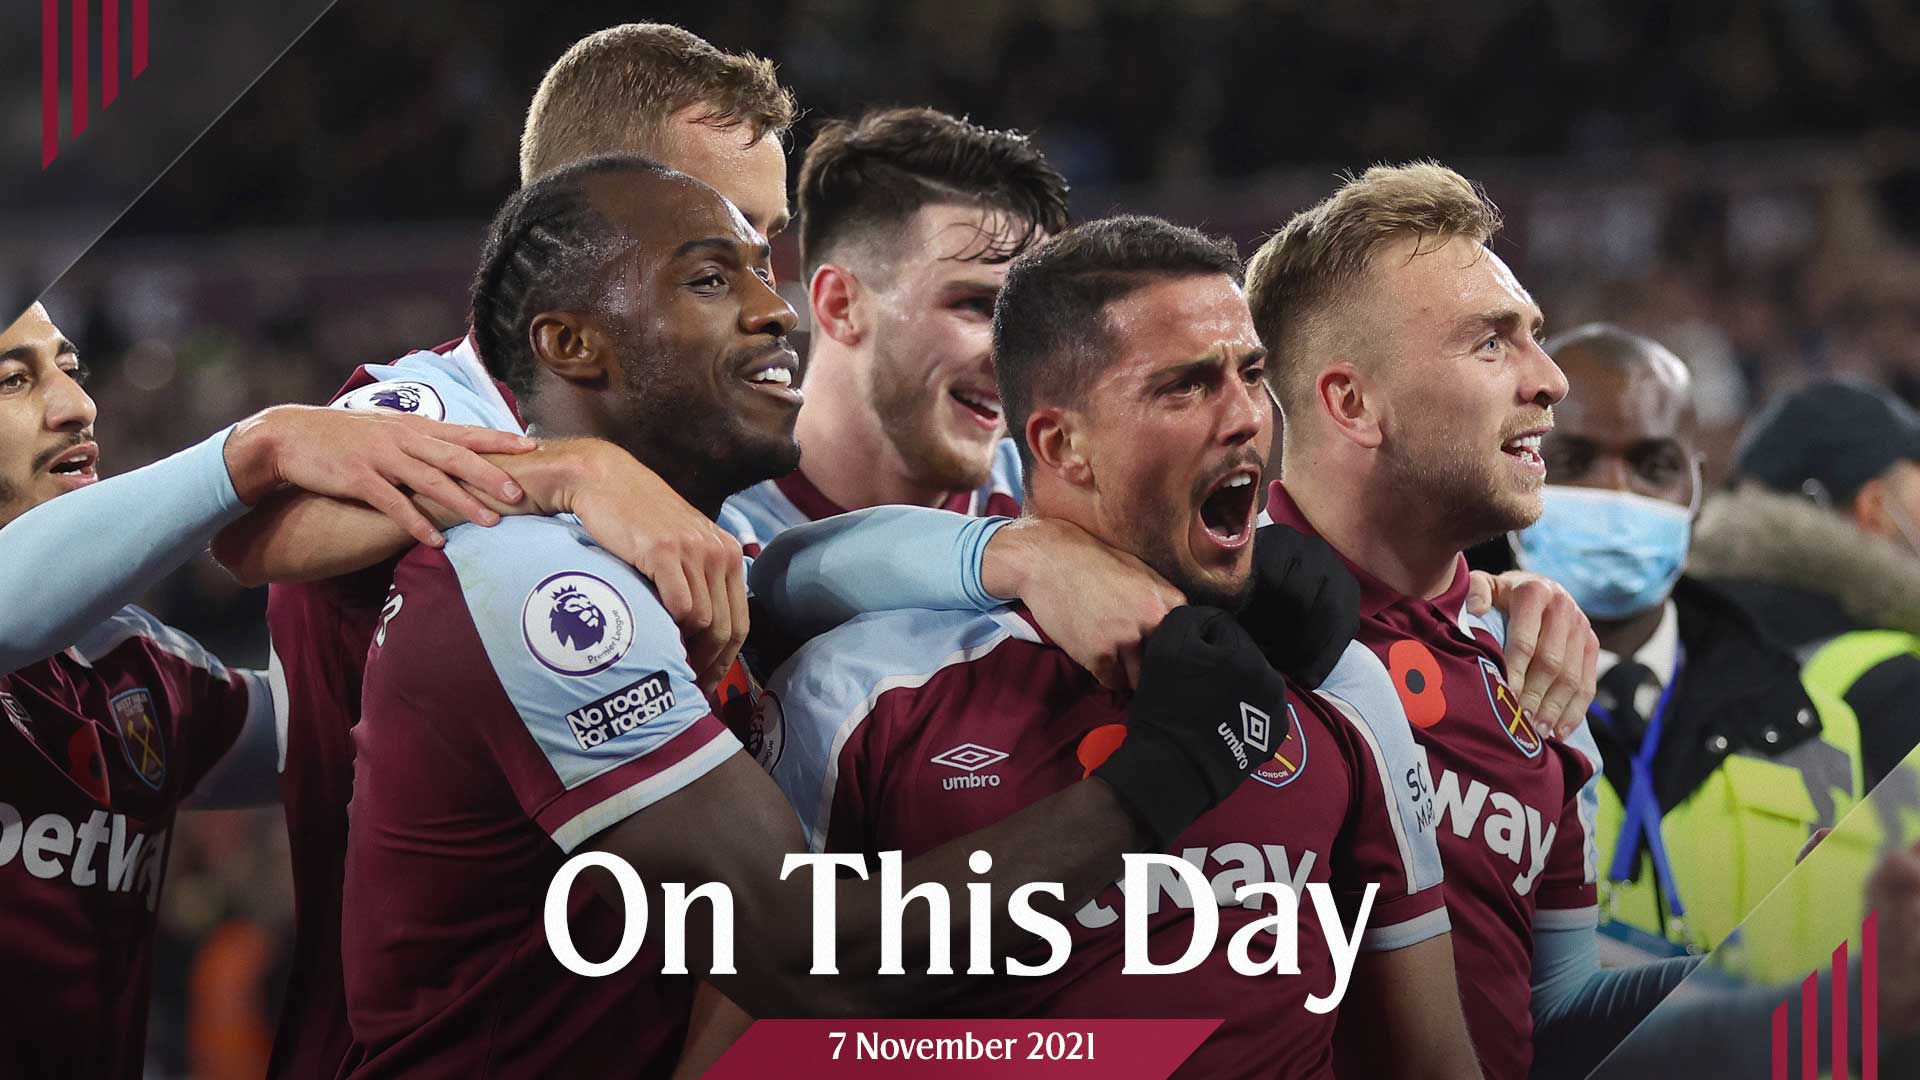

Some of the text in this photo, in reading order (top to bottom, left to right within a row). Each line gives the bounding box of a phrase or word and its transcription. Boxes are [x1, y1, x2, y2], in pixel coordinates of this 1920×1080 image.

[587, 610, 625, 664] Premier League
[566, 678, 663, 733] No room
[575, 691, 675, 750] for racism
[1217, 722, 1248, 770] umbro
[942, 773, 1001, 790] umbro
[1257, 769, 1289, 779] LONDON
